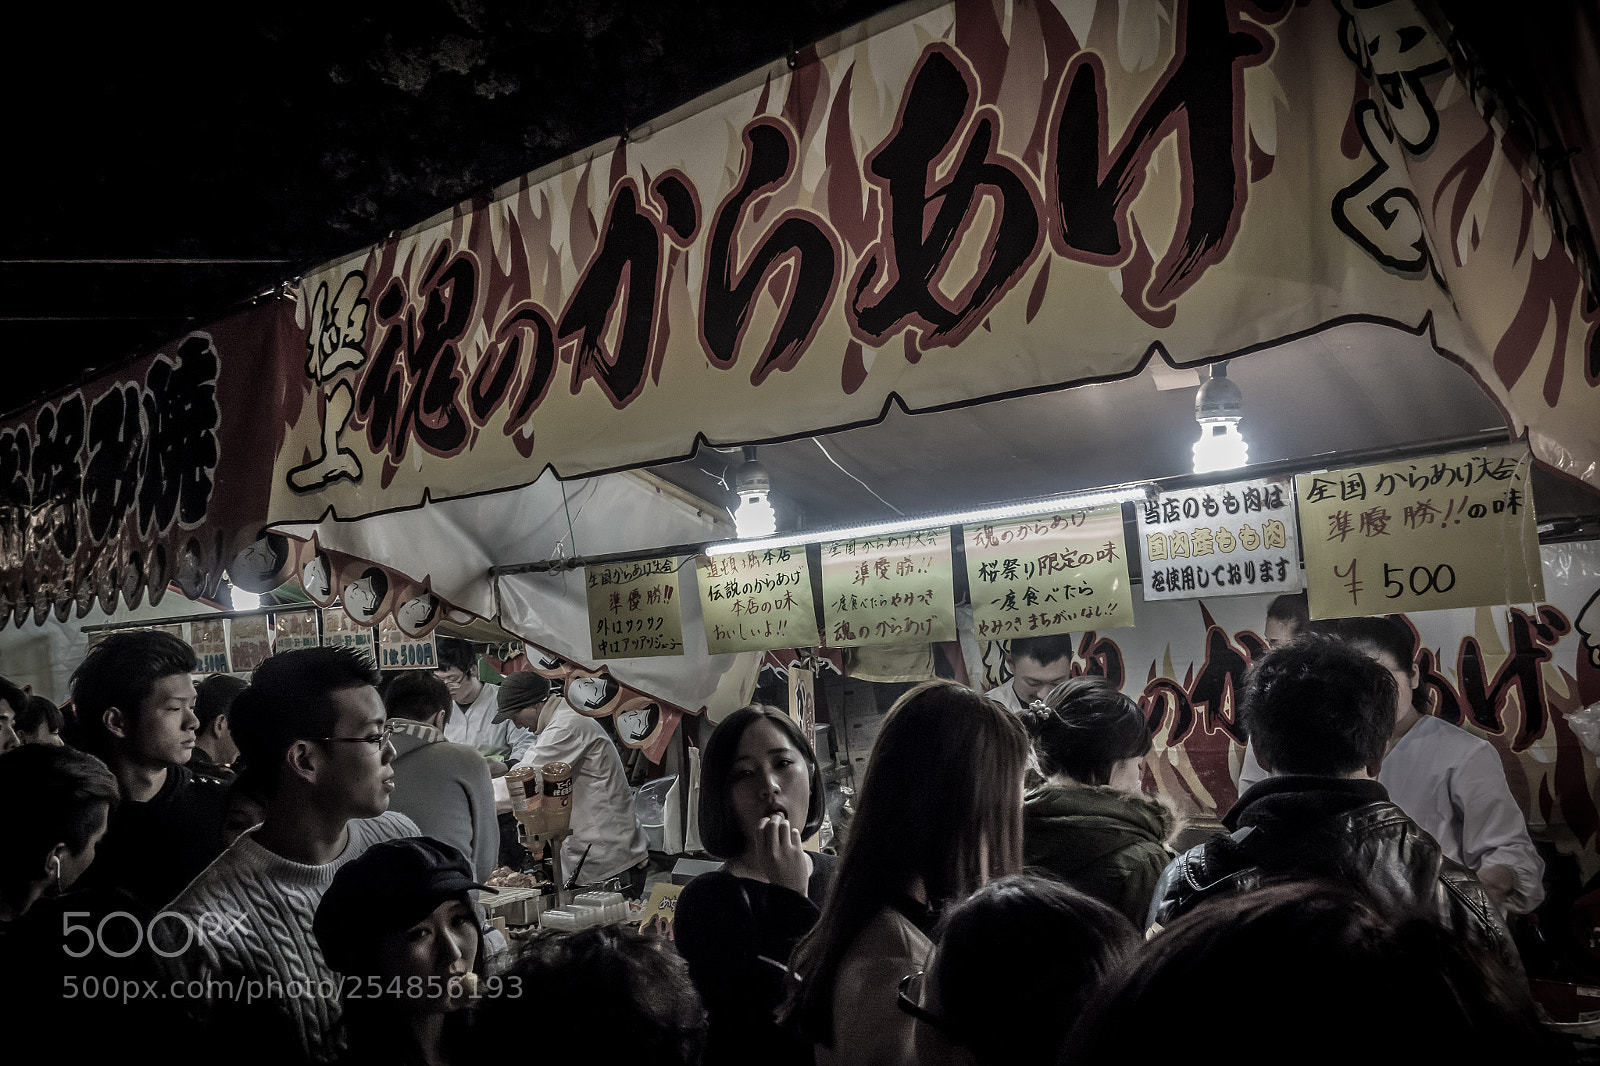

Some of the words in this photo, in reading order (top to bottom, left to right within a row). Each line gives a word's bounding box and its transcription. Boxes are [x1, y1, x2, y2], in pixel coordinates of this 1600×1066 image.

[1145, 485, 1286, 525] 当店のもも肉は
[1146, 519, 1286, 562] 国内産もも肉
[704, 549, 791, 578] 道頓堀本店
[978, 541, 1120, 583] 桜祭り限定の味
[1152, 556, 1289, 593] を使用しております
[708, 566, 803, 601] 伝説のからあげ
[991, 580, 1094, 612] 一度食べたら
[609, 584, 674, 615] 準優勝!!
[731, 589, 798, 617] 本店の味
[831, 589, 934, 613] 一度食べたらやみつき
[597, 617, 664, 636] 外はサクサク
[713, 620, 788, 640] おいしいよ!!
[834, 615, 938, 641] 魂のからあげ
